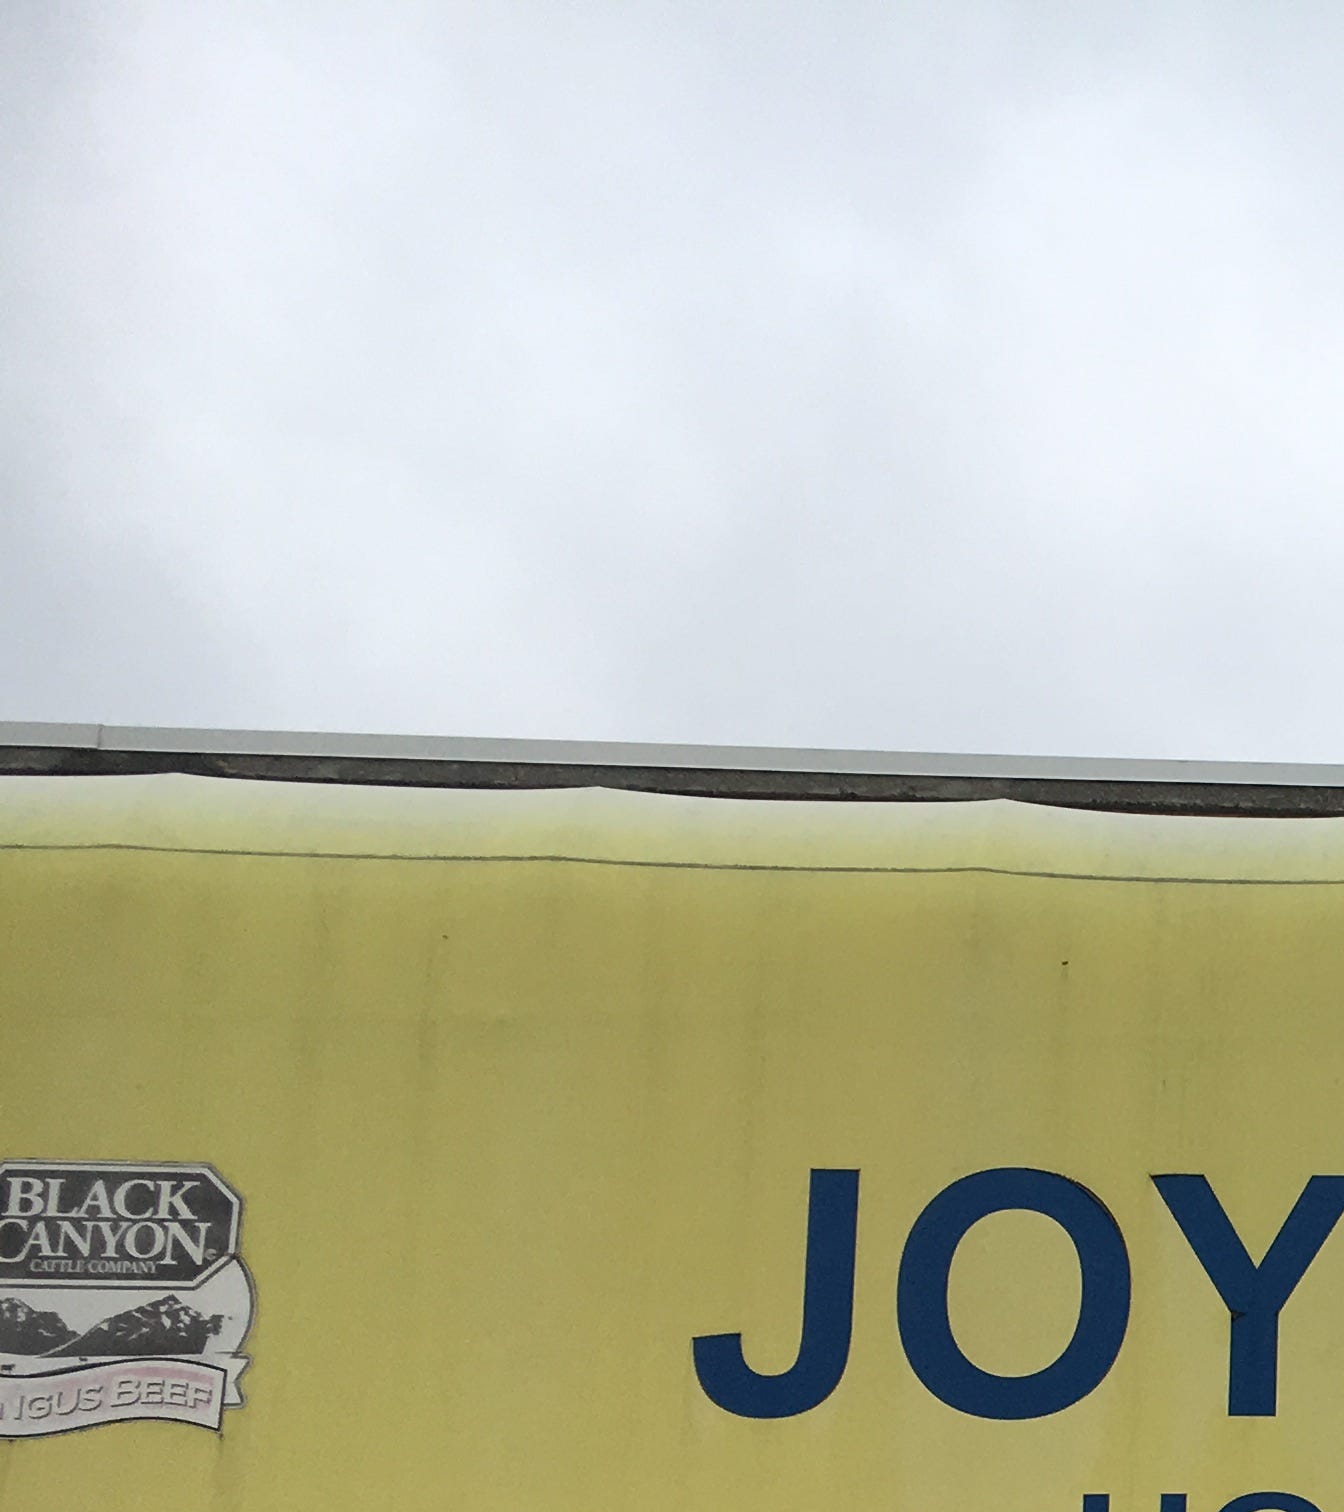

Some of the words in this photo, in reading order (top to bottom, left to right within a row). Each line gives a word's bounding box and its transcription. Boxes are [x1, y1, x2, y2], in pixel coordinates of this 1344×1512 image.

[1, 1177, 200, 1220] BLACK
[0, 1218, 211, 1265] CANYON
[30, 1259, 85, 1273] CATTLE
[88, 1260, 158, 1275] COMPANY
[110, 1375, 213, 1409] BEEF
